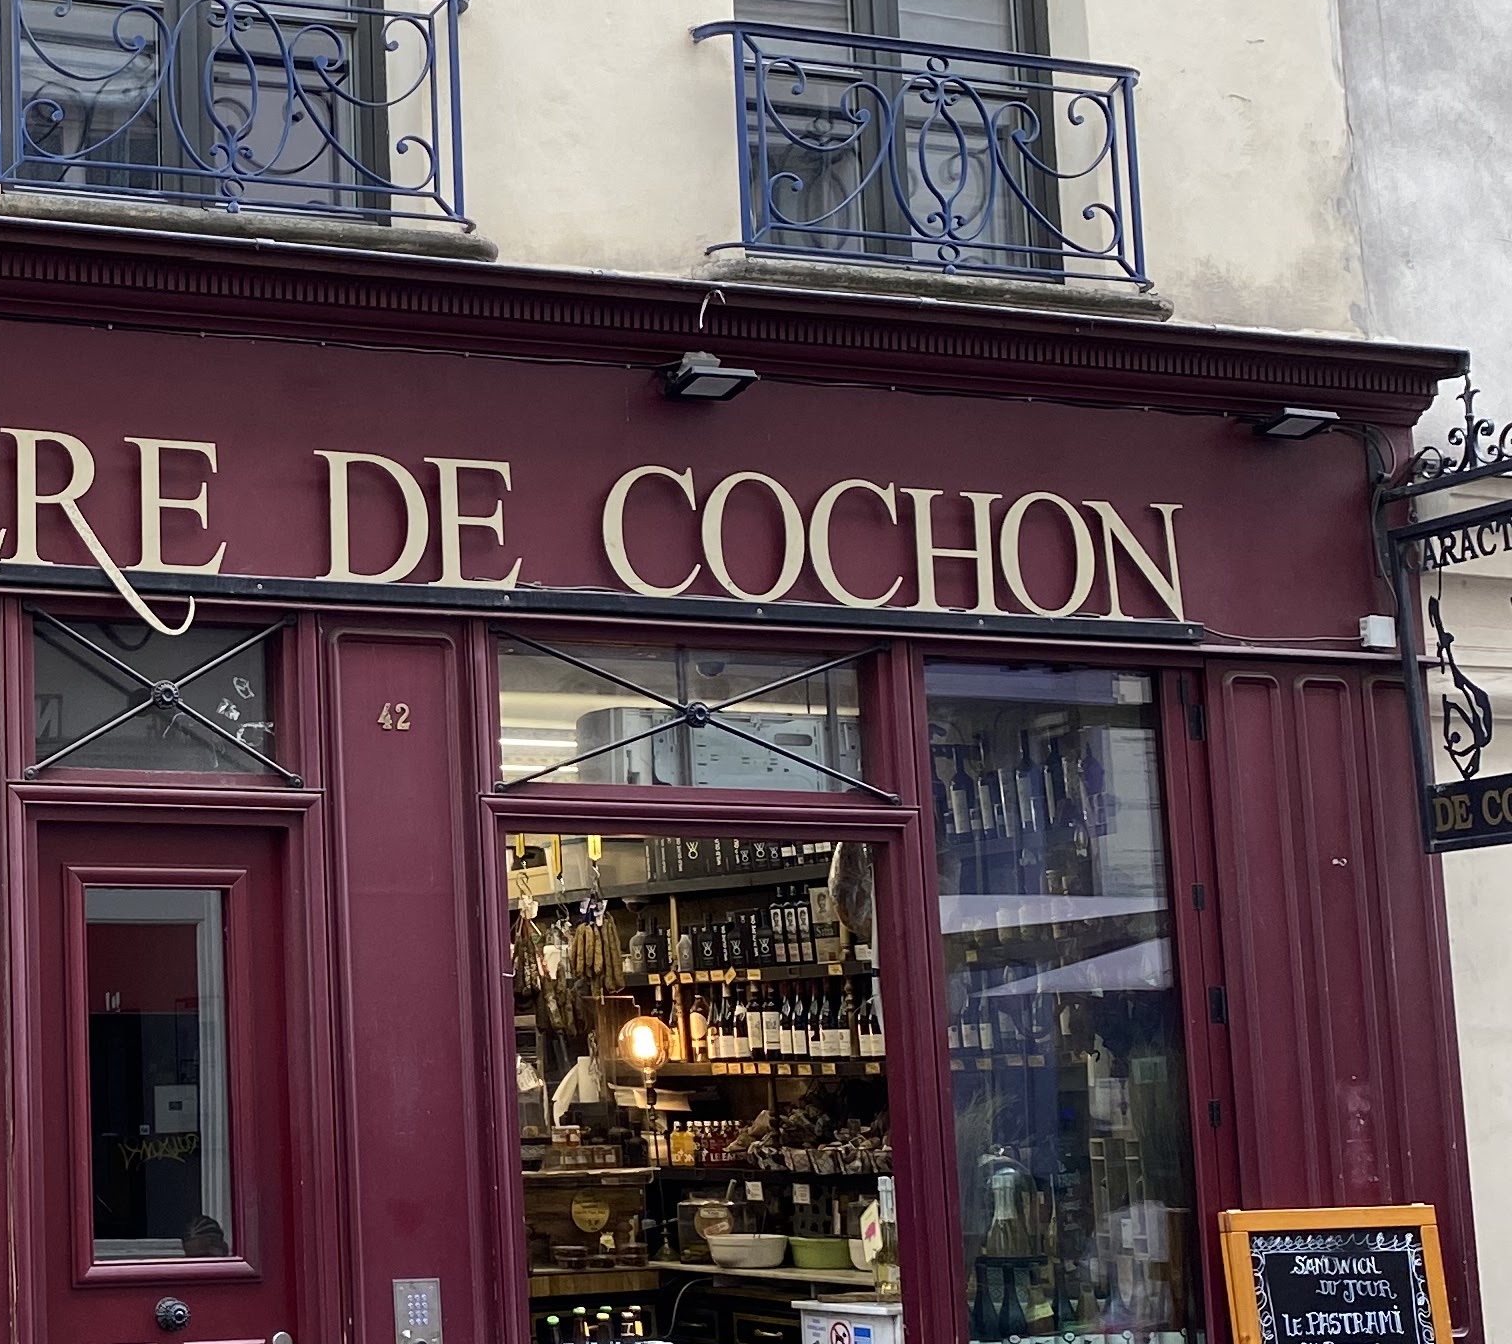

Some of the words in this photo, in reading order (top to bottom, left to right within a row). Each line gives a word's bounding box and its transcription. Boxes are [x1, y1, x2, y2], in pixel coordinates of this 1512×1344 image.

[314, 449, 523, 590] DE
[602, 464, 1184, 623] COCHON
[376, 702, 411, 731] 42
[1432, 794, 1473, 832] DE
